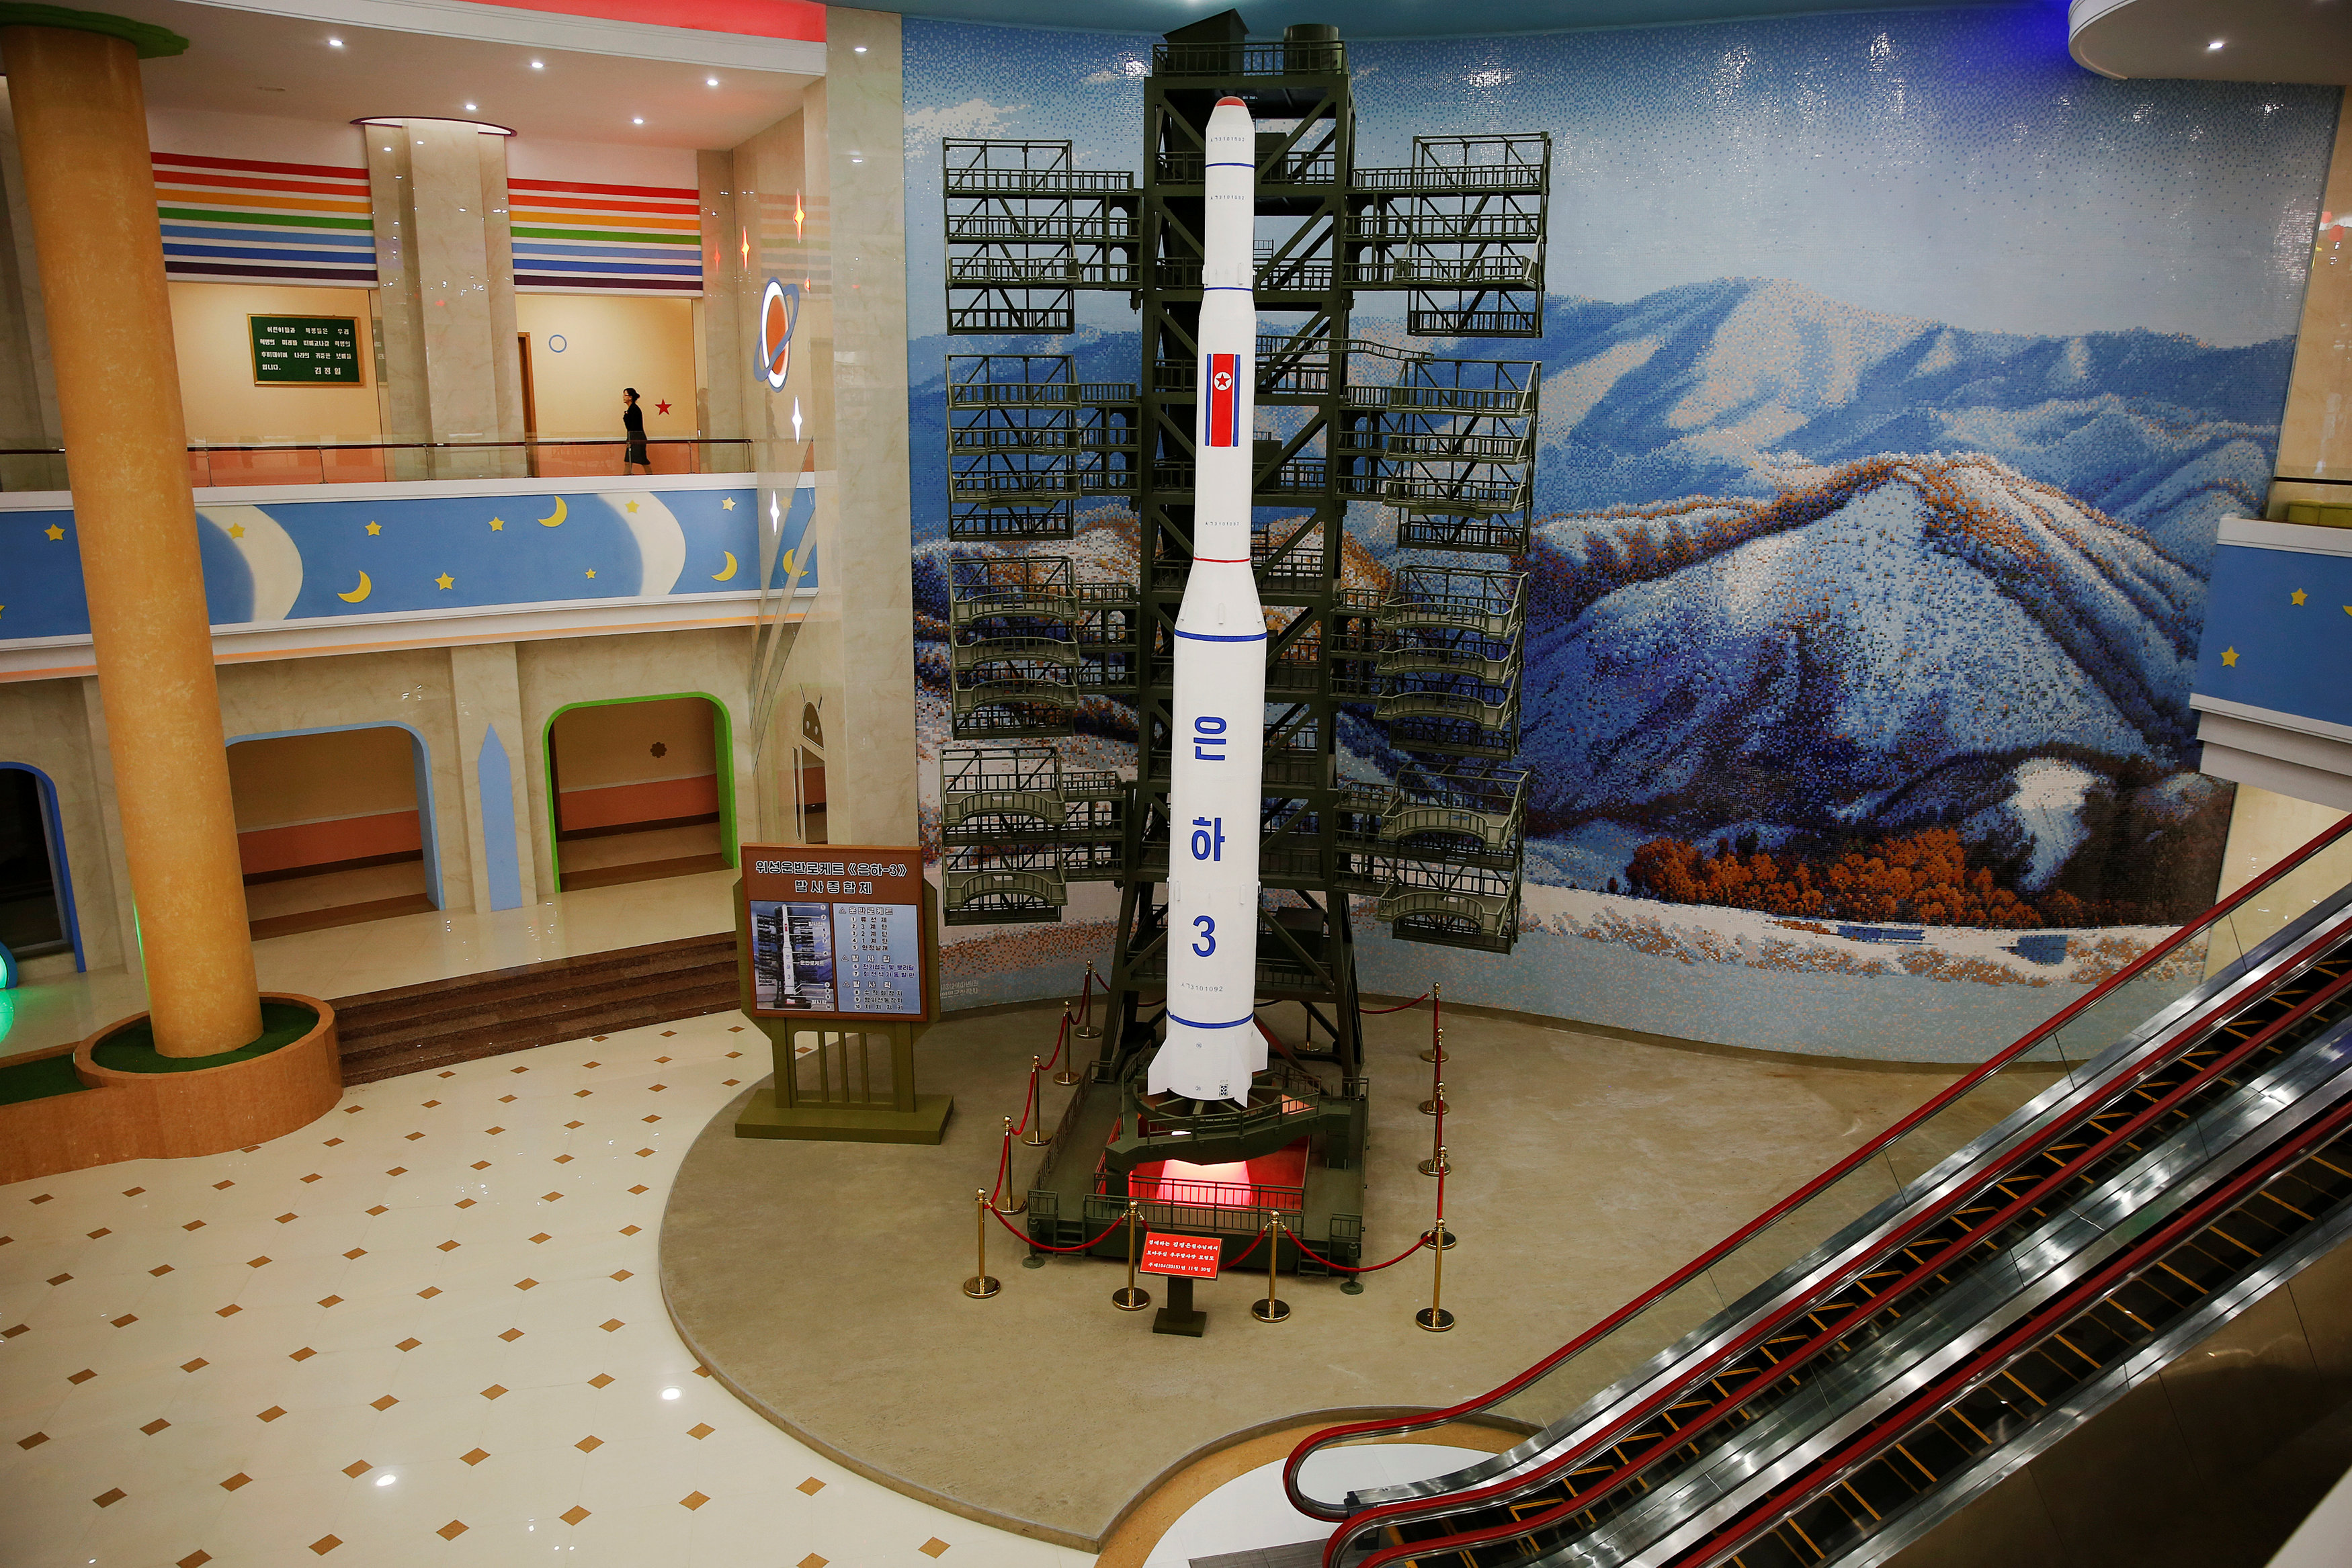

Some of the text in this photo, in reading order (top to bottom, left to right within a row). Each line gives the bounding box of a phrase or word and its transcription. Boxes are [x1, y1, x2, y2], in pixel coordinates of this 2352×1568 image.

[756, 861, 907, 877] 위성운반로케트 《은하-3》
[795, 880, 872, 894] 발사종합체
[849, 907, 893, 915] 운반로케트
[1192, 915, 1216, 957] 3
